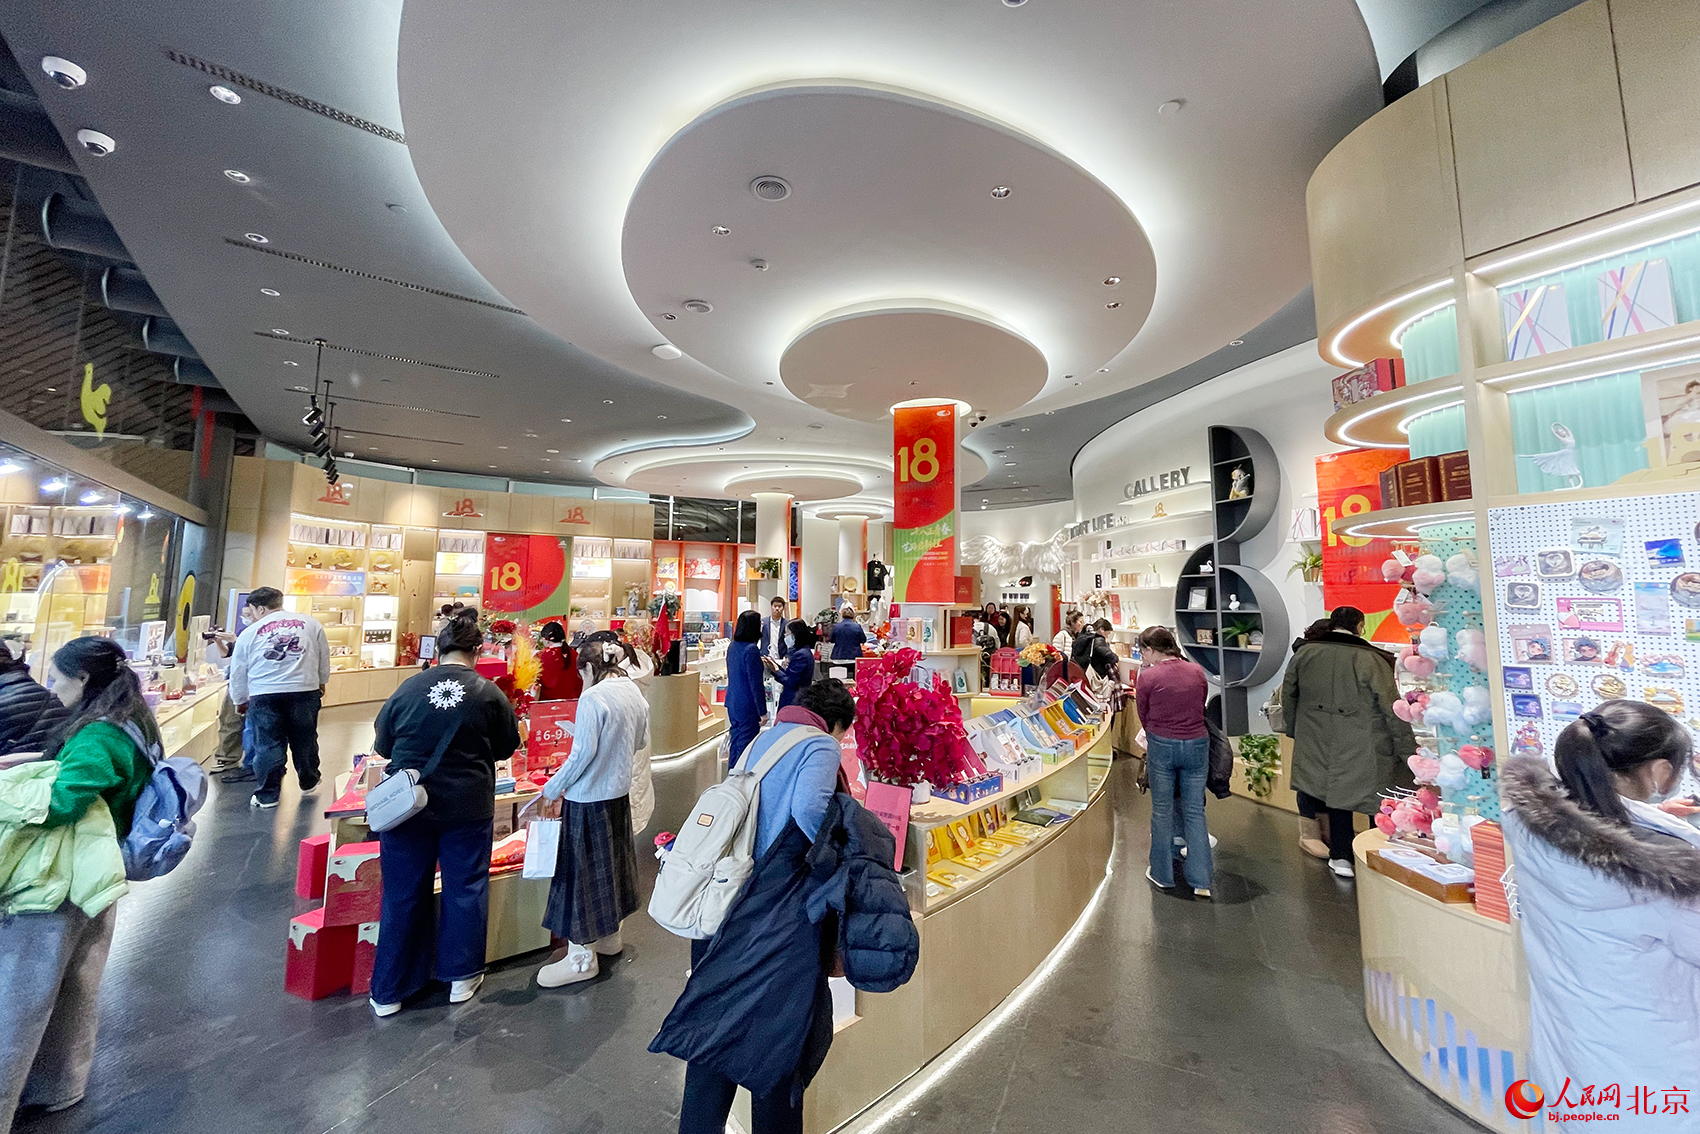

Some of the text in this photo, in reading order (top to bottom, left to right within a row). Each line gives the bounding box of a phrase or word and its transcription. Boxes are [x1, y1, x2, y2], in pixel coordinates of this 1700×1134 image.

[897, 437, 940, 483] 18
[1123, 466, 1191, 499] GALLERY
[455, 498, 475, 513] 18
[567, 506, 585, 520] 18
[1322, 494, 1374, 548] 18
[1092, 512, 1114, 532] LIFE
[490, 561, 523, 592] 18
